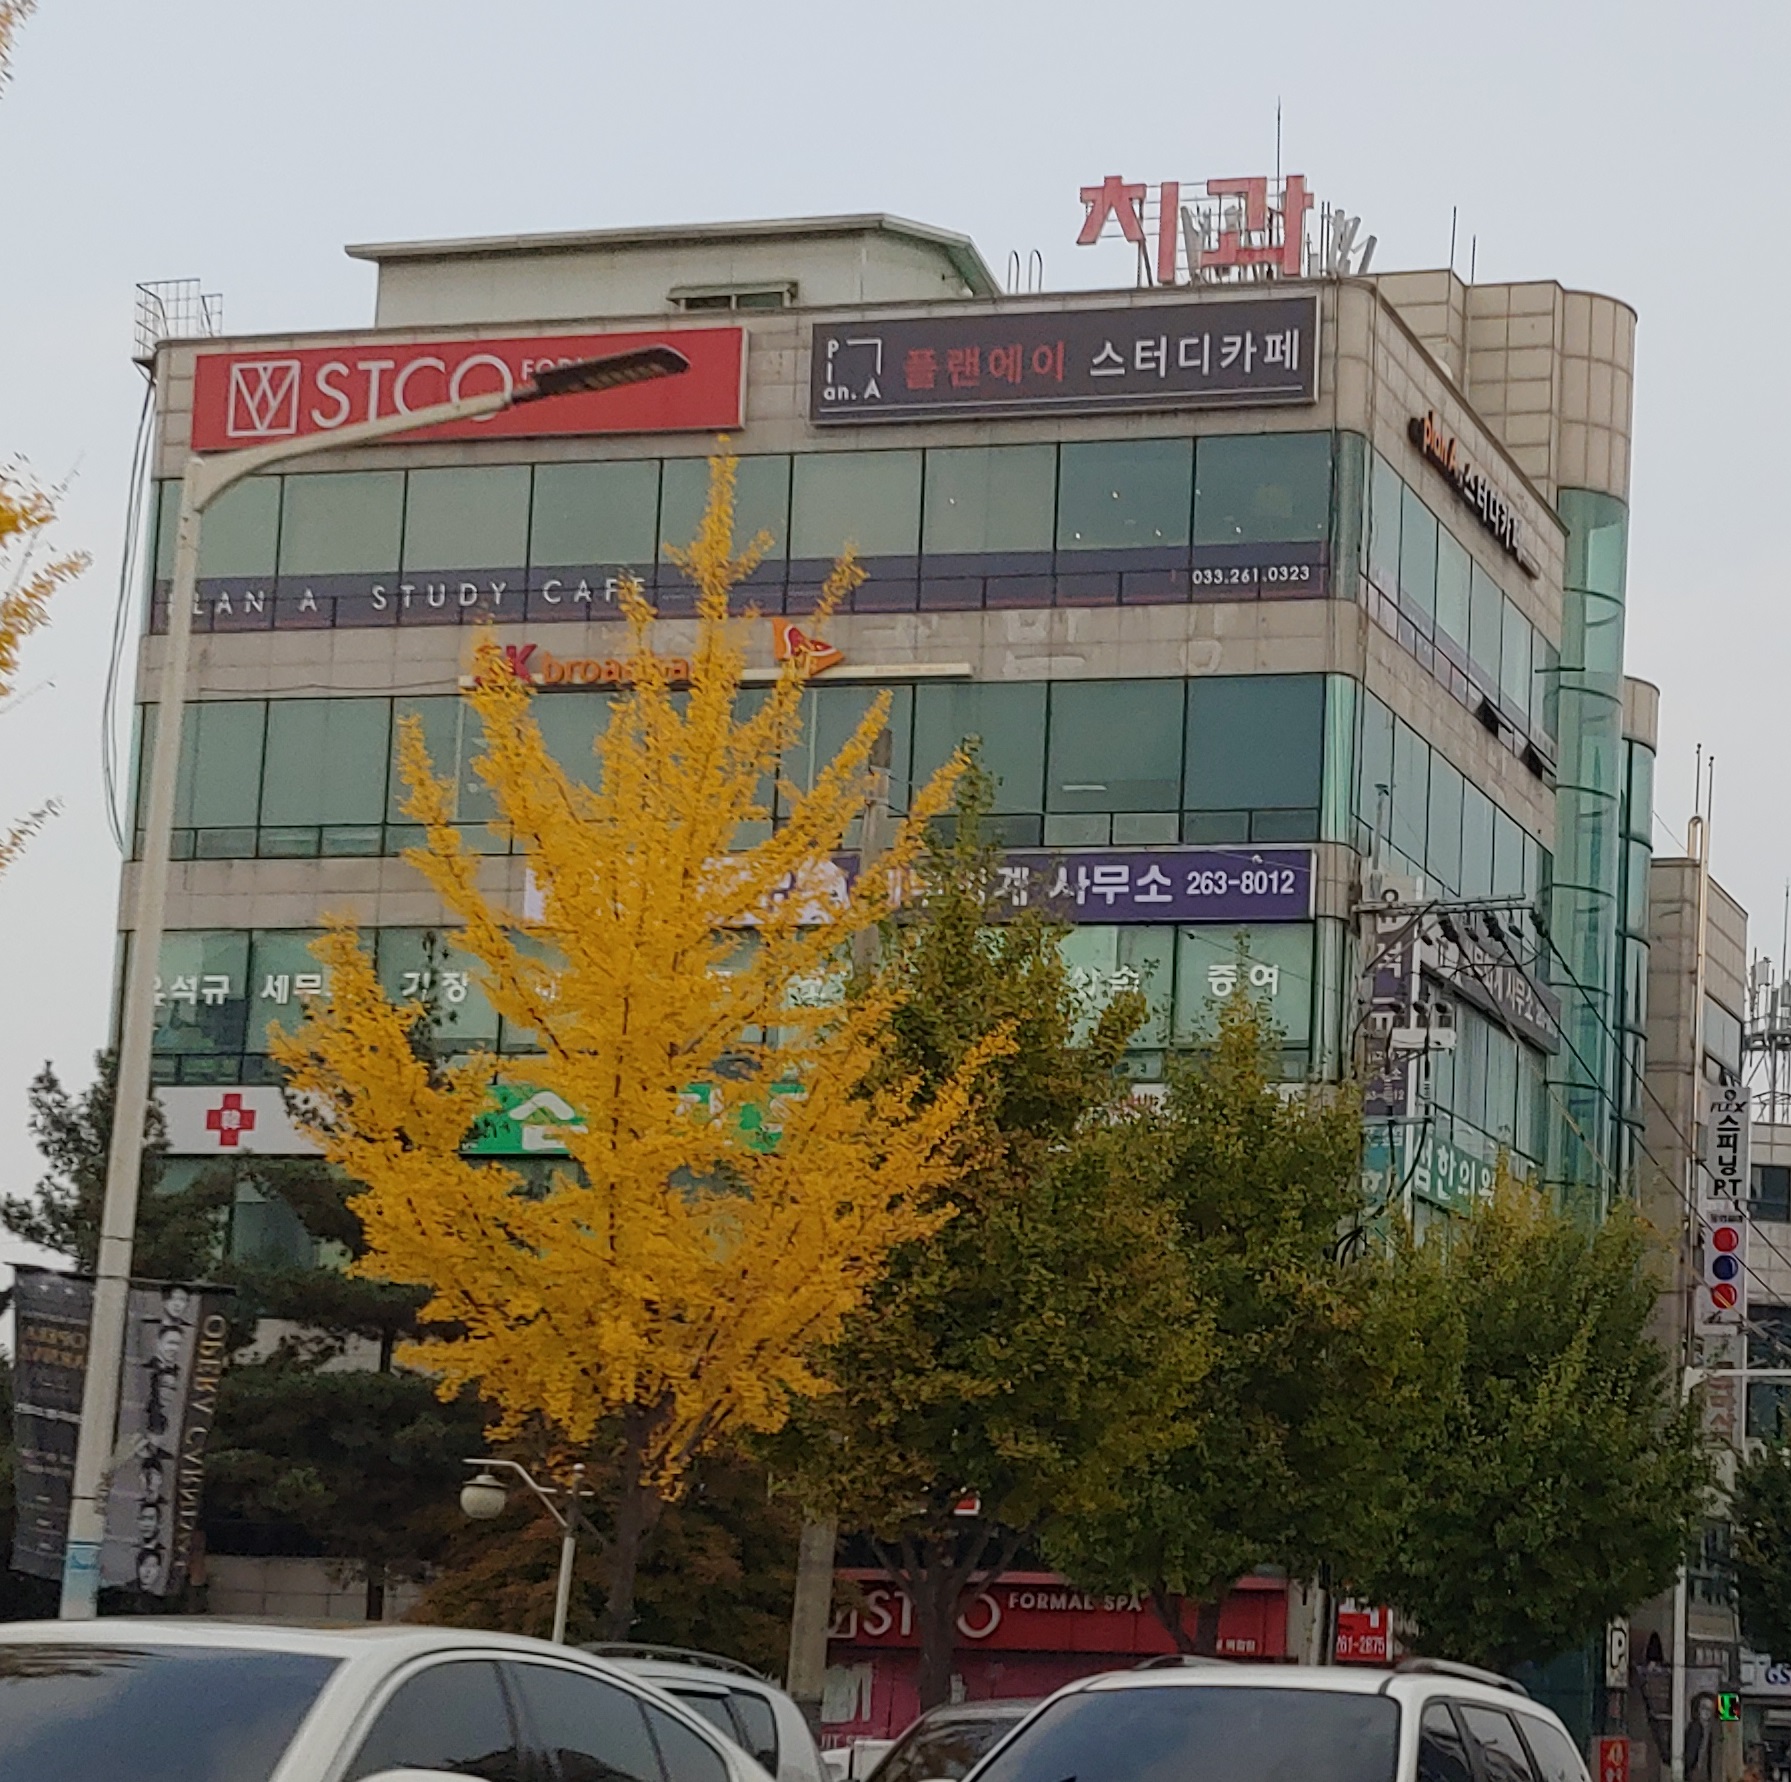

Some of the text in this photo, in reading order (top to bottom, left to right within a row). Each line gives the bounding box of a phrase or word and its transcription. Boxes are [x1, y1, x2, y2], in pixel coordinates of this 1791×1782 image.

[1076, 175, 1314, 283] 치과
[905, 328, 1299, 390] 플랜에이 스터디카페
[311, 354, 513, 429] STCO
[1192, 565, 1310, 585] 033.261.0323
[167, 592, 266, 616] LAN
[299, 588, 317, 612] A
[371, 582, 507, 611] STUDY
[1050, 864, 1173, 907] 사무소
[1186, 869, 1295, 896] 263-8012
[261, 973, 337, 1005] 세무
[1208, 963, 1280, 997] 증여
[1716, 1115, 1741, 1176] 스피닝
[1713, 1179, 1742, 1196] PT
[863, 1589, 1143, 1639] STO FORMAL SPA
